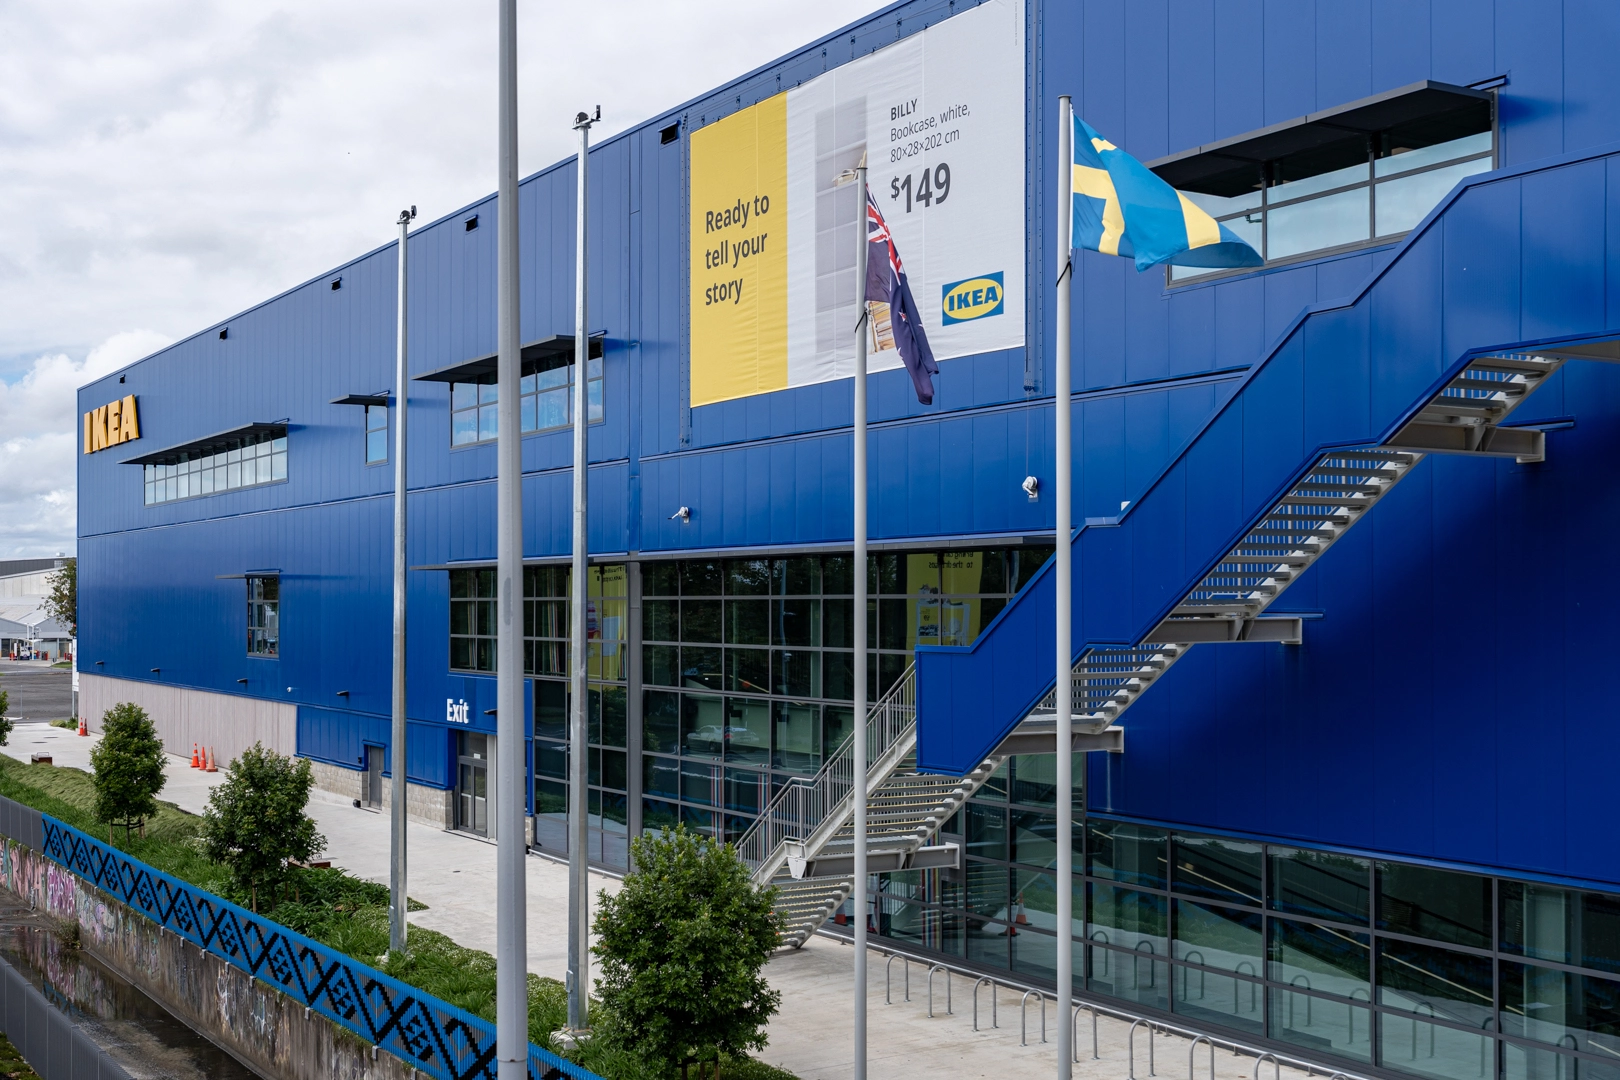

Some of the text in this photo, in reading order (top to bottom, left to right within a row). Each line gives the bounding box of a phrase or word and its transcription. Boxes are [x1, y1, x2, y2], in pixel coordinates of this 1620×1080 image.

[890, 98, 918, 121] BILLY
[890, 104, 971, 142] Bookcase, white,
[944, 129, 960, 144] cm
[890, 162, 951, 214] $149
[705, 195, 770, 234] Ready to
[705, 233, 768, 270] tell your
[705, 278, 744, 306] story
[948, 285, 999, 312] IKEA
[83, 393, 140, 455] IKEA
[446, 698, 470, 724] Exit
